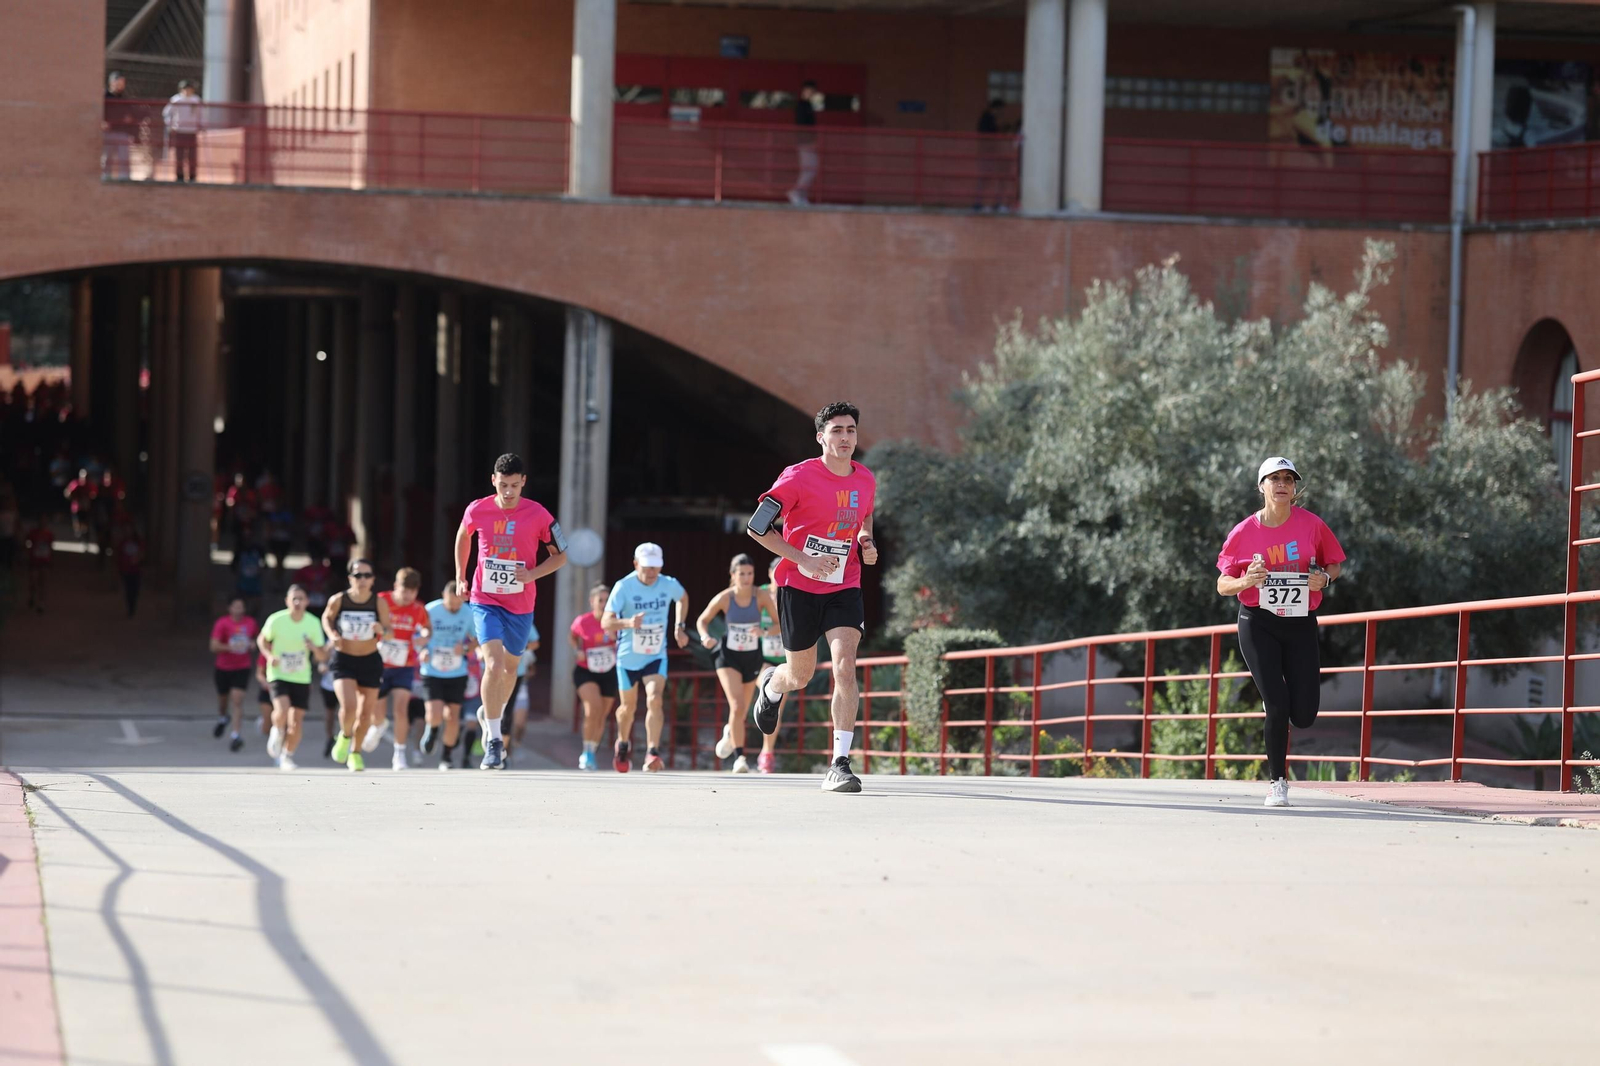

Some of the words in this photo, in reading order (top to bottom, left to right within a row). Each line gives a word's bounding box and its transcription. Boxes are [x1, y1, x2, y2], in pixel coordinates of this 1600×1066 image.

[1316, 119, 1346, 142] de
[1351, 122, 1443, 149] málaga
[836, 490, 858, 508] WE
[837, 510, 857, 522] RUN
[494, 521, 516, 535] WE
[808, 541, 829, 553] UMA
[1266, 540, 1300, 565] WE
[485, 562, 504, 571] UMA
[489, 571, 518, 586] 492
[1267, 587, 1302, 605] 372
[634, 598, 667, 611] nerja
[349, 622, 370, 634] 377
[640, 635, 661, 646] 715
